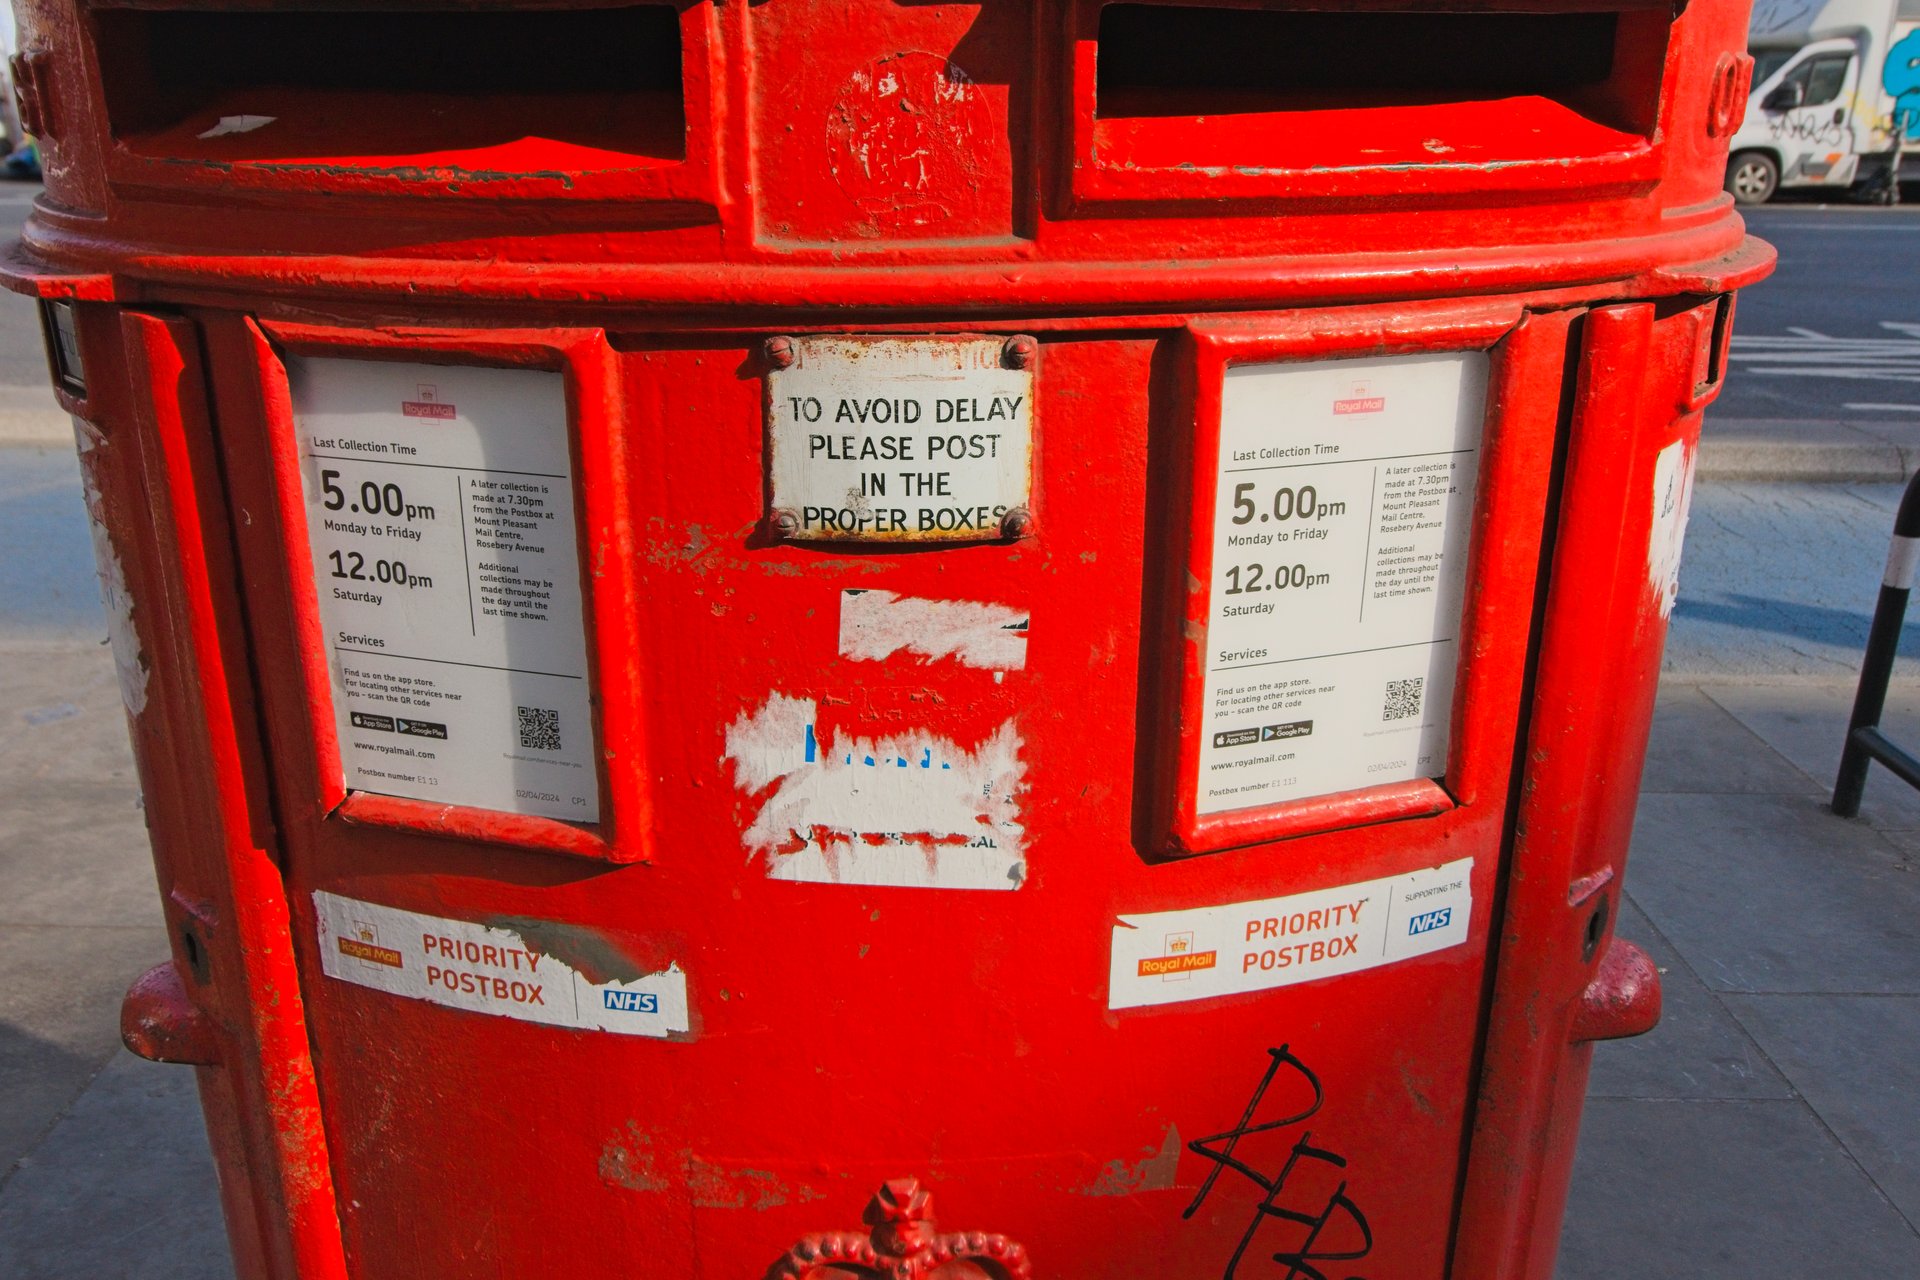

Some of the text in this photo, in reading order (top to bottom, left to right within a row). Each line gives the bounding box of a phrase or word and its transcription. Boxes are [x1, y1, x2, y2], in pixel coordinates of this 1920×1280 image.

[406, 404, 453, 416] Royal Mail
[788, 396, 1023, 424] TO AVOID DELAY
[1336, 400, 1382, 412] Royal Mail
[314, 436, 416, 455] Last Collection Time
[809, 434, 1001, 460] PLEASE POST
[1233, 444, 1339, 461] Last Collection Time
[1413, 463, 1447, 472] collection
[1450, 462, 1455, 470] is
[479, 480, 498, 489] later
[501, 483, 538, 492] collection
[542, 485, 548, 493] is
[861, 471, 951, 496] IN THE
[1385, 480, 1405, 488] made
[1418, 475, 1449, 485] 7.30pm
[322, 470, 435, 522] 5.00pm
[1419, 488, 1446, 496] Postbox
[472, 494, 494, 502] made
[508, 495, 543, 507] 7.30pm
[1232, 482, 1345, 525] 5.00pm
[1383, 499, 1440, 511] Mount Pleasant
[473, 505, 492, 513] from
[495, 507, 508, 515] the
[512, 508, 543, 518] Postbox
[803, 505, 1008, 532] PROPER BOXES
[324, 519, 421, 541] Monday to Friday
[475, 517, 538, 529] Mount Pleasant
[1380, 523, 1414, 533] Rosebery
[476, 528, 523, 540] Mail Centre,
[1228, 528, 1328, 547] Monday to Friday
[477, 540, 544, 553] Rosebery Avenue
[1378, 545, 1415, 555] Additional
[479, 562, 518, 573] Additional
[1377, 556, 1415, 566] collections
[1418, 554, 1432, 562] may
[329, 550, 432, 589] 12.00pm
[1376, 564, 1438, 577] made throughout
[480, 575, 553, 588] collections may be
[1225, 563, 1329, 595] 12.00pm
[1375, 580, 1386, 588] the
[1389, 579, 1401, 587] day
[1404, 576, 1420, 584] until
[333, 588, 382, 605] Saturday
[505, 588, 550, 599] throughout
[1389, 589, 1405, 597] time
[1408, 586, 1432, 594] shown.
[482, 596, 494, 604] the
[498, 598, 511, 607] day
[514, 600, 532, 608] until
[483, 607, 548, 621] last time shown.
[1223, 603, 1275, 617] Saturday
[340, 632, 385, 647] Services
[1220, 648, 1267, 662] Services
[344, 668, 359, 677] Find
[399, 677, 411, 685] app
[414, 679, 435, 687] store.
[360, 681, 388, 692] locating
[413, 688, 442, 698] services
[1217, 688, 1233, 696] Find
[1260, 683, 1271, 691] the
[1274, 680, 1287, 689] app
[1231, 695, 1261, 705] locating
[1264, 692, 1283, 700] other
[1286, 688, 1316, 697] services
[1319, 685, 1335, 693] near
[401, 696, 411, 704] QR
[414, 699, 430, 707] code
[1215, 710, 1228, 718] you
[1237, 705, 1254, 714] scan
[1285, 700, 1302, 708] code
[1226, 735, 1238, 744] App
[1277, 728, 1298, 737] Google
[354, 742, 435, 759] www.royalmail.com
[1211, 753, 1295, 771] www.royalmail.com
[358, 767, 385, 777] Postbox
[388, 773, 415, 782] number
[1209, 783, 1269, 796] Postbox number
[516, 790, 586, 806] 02/04/2024 CP1
[1405, 881, 1462, 902] SUPPORTING THE
[1246, 901, 1364, 942] PRIORITY
[1410, 909, 1449, 934] NHS
[341, 940, 399, 964] Royal Mail
[423, 934, 540, 973] PRIORITY
[1243, 934, 1358, 974] POSTBOX
[1142, 952, 1212, 972] Royal Mail
[427, 966, 544, 1005] POSTBOX
[607, 992, 654, 1011] NHS
